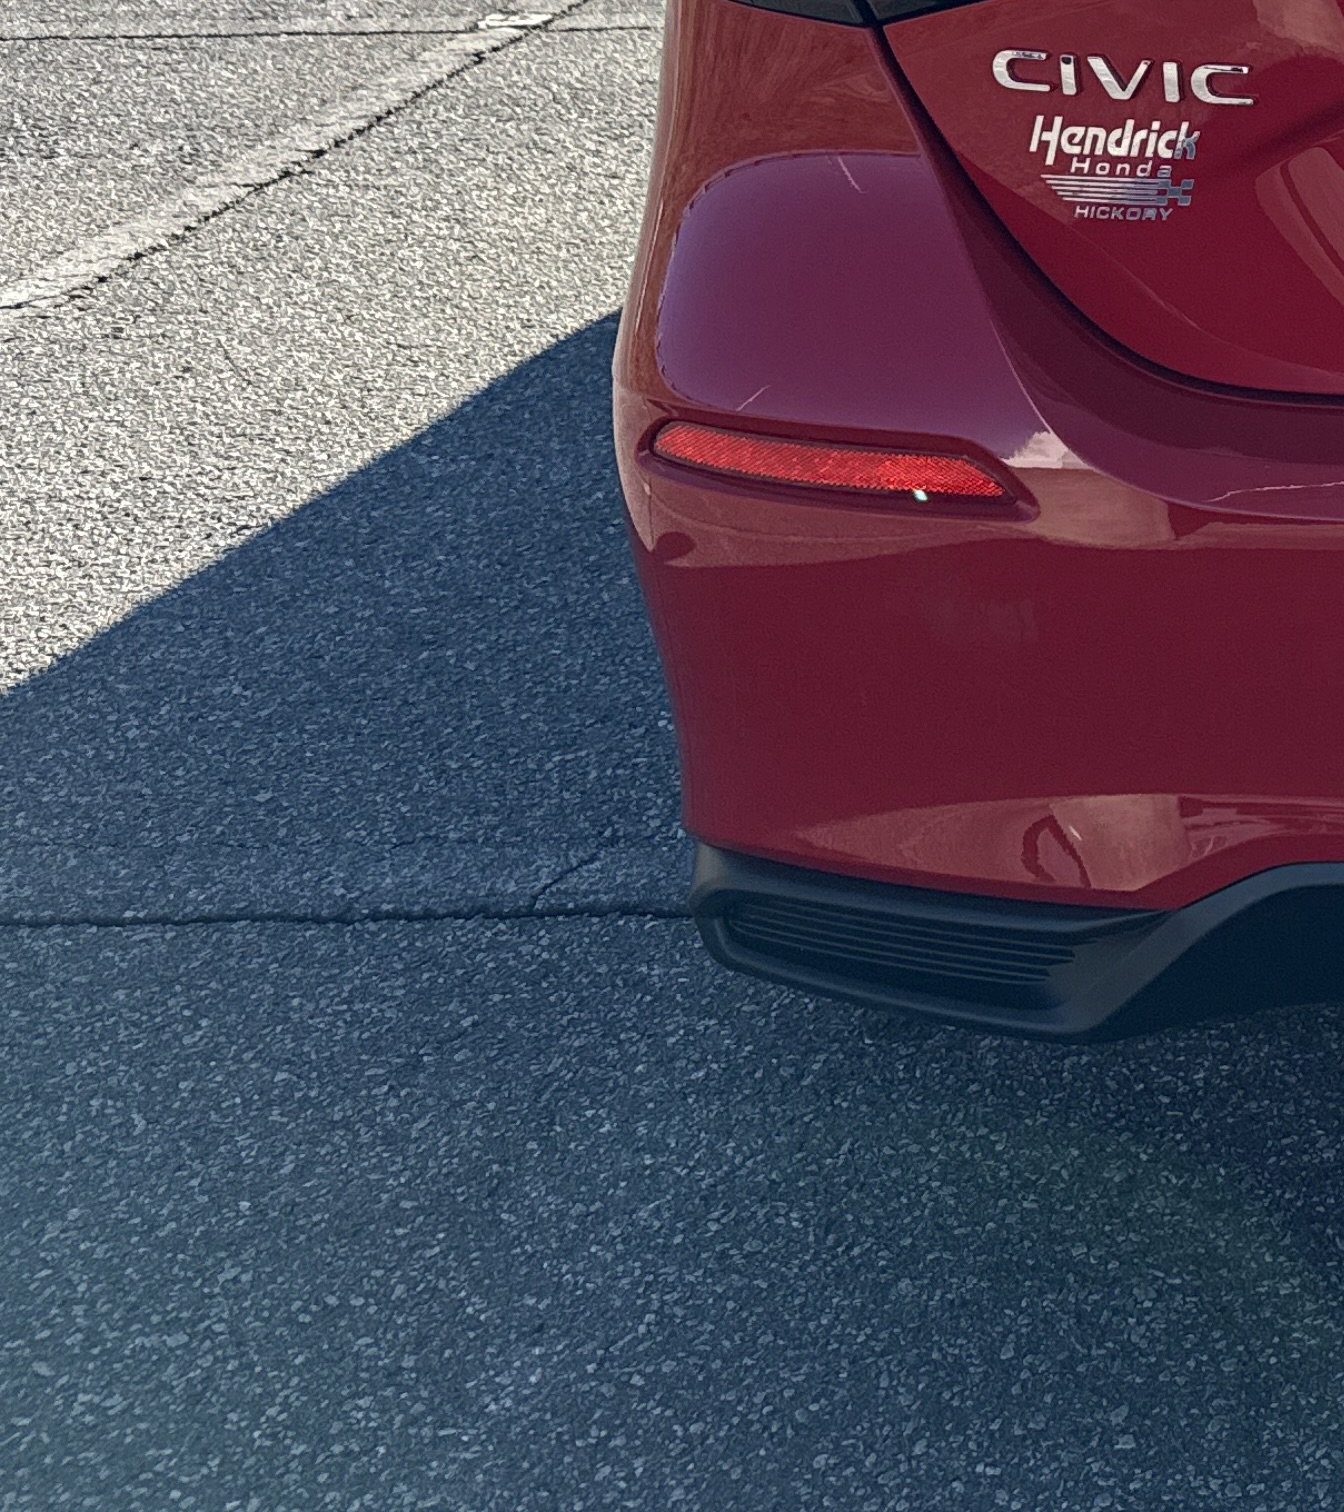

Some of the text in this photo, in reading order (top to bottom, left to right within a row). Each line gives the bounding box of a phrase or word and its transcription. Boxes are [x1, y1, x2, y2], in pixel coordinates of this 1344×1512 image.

[991, 49, 1255, 106] CIVIC
[1029, 114, 1201, 166] Hendrick
[1070, 156, 1173, 179] Honda
[1073, 204, 1174, 221] HICKORY
